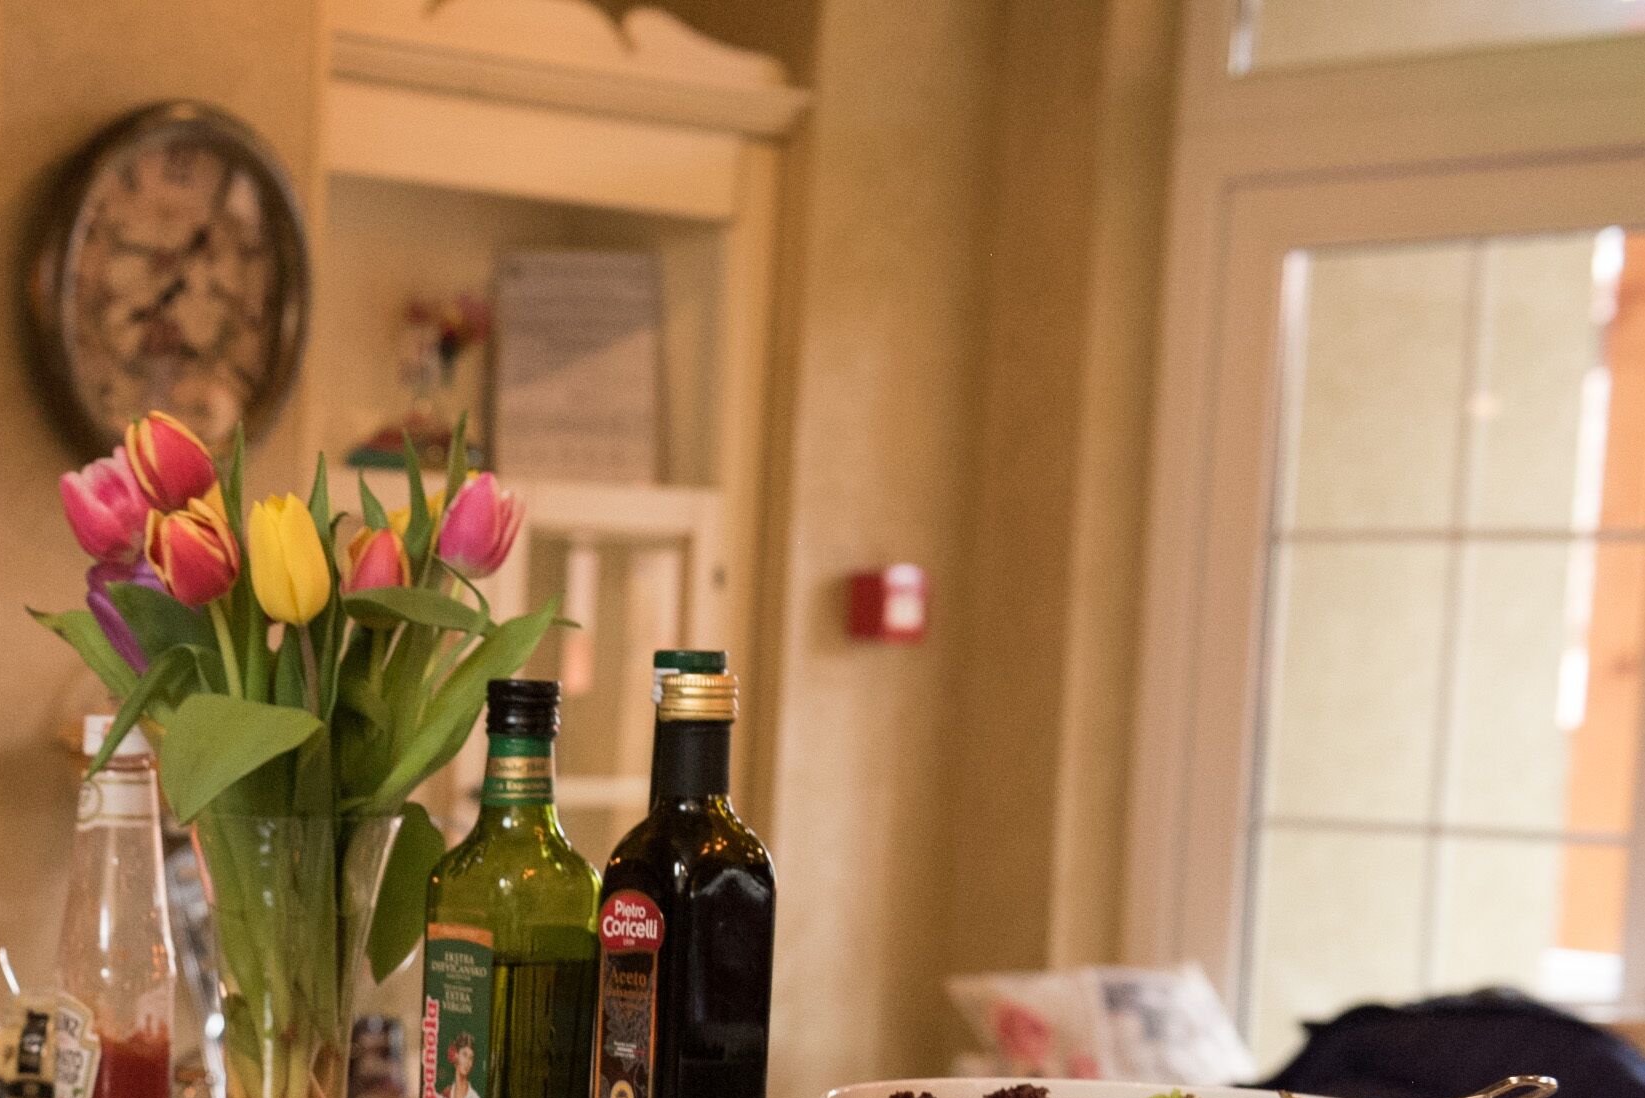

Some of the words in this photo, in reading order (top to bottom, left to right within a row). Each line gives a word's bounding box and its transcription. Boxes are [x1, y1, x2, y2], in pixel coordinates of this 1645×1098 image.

[615, 899, 646, 919] Pietro
[602, 915, 658, 939] Coricelli
[608, 966, 647, 987] Aceto
